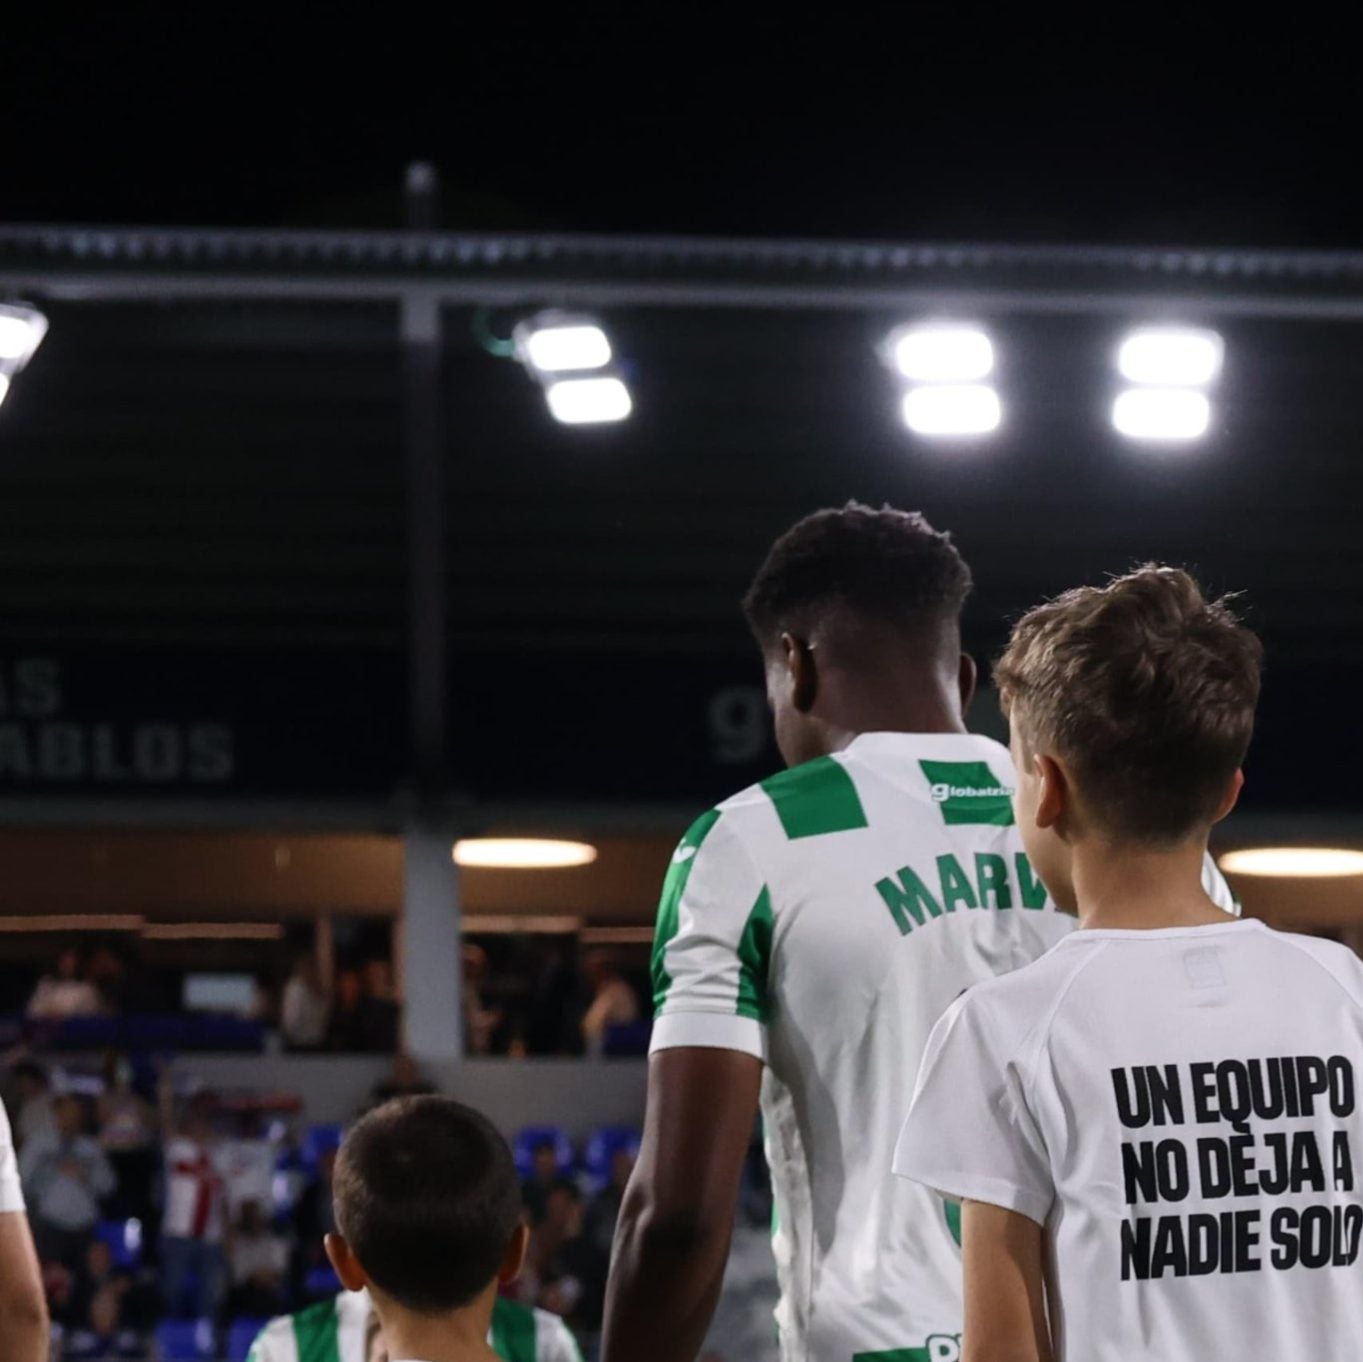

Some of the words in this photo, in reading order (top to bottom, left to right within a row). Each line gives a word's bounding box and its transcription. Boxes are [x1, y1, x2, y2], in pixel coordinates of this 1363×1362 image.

[1110, 1064, 1185, 1129] UN
[1189, 1055, 1355, 1134] EQUIPO
[1121, 1138, 1190, 1205] NO
[1197, 1131, 1325, 1199] DEJA
[1332, 1131, 1354, 1192] A
[1120, 1209, 1261, 1281] NADIE
[1270, 1204, 1363, 1270] SOLO
